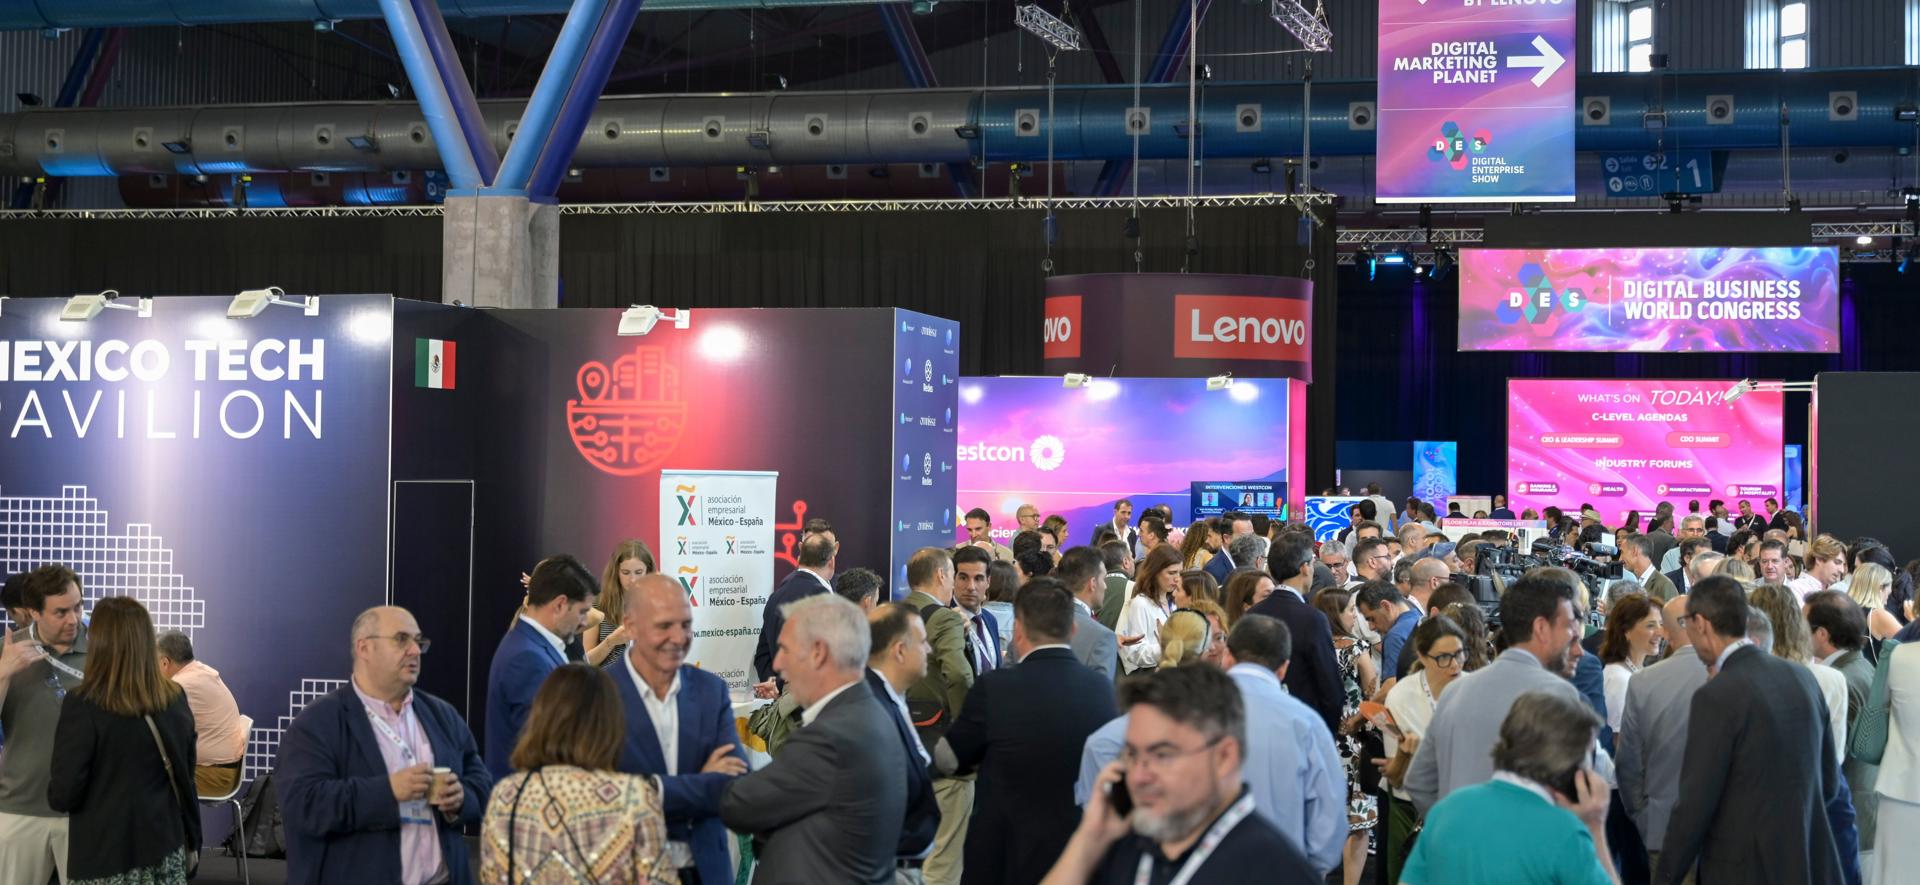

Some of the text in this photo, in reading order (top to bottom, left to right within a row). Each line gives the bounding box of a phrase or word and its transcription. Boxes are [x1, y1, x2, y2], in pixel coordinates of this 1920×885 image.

[1431, 42, 1497, 56] DIGITAL
[1393, 56, 1497, 71] MARKETING
[1433, 70, 1497, 84] PLANET
[1472, 157, 1506, 165] DIGITAL
[1472, 166, 1525, 174] ENTERPRISE
[1686, 159, 1702, 188] 1
[1472, 175, 1500, 183] SHOW
[1623, 280, 1801, 300] DIGITAL BUSINESS
[1624, 301, 1801, 320] WORLD CONGRESS
[1191, 308, 1306, 346] Lenovo
[0, 338, 325, 382] EXICO TECH
[1577, 390, 1724, 406] WHAT'S ON TODAY!
[0, 389, 323, 439] AVILION
[1591, 412, 1688, 422] C-LEVEL AGENDAS
[957, 441, 1025, 462] estcon
[1595, 459, 1694, 469] INDUSTRY FORUMS
[707, 494, 742, 504] asociación
[707, 505, 746, 516] empresarial
[708, 516, 734, 526] México
[740, 516, 764, 528] España
[709, 574, 744, 584] asociación
[709, 584, 748, 596] empresarial
[709, 596, 736, 607] México
[741, 595, 767, 607] España
[727, 679, 750, 689] esarial
